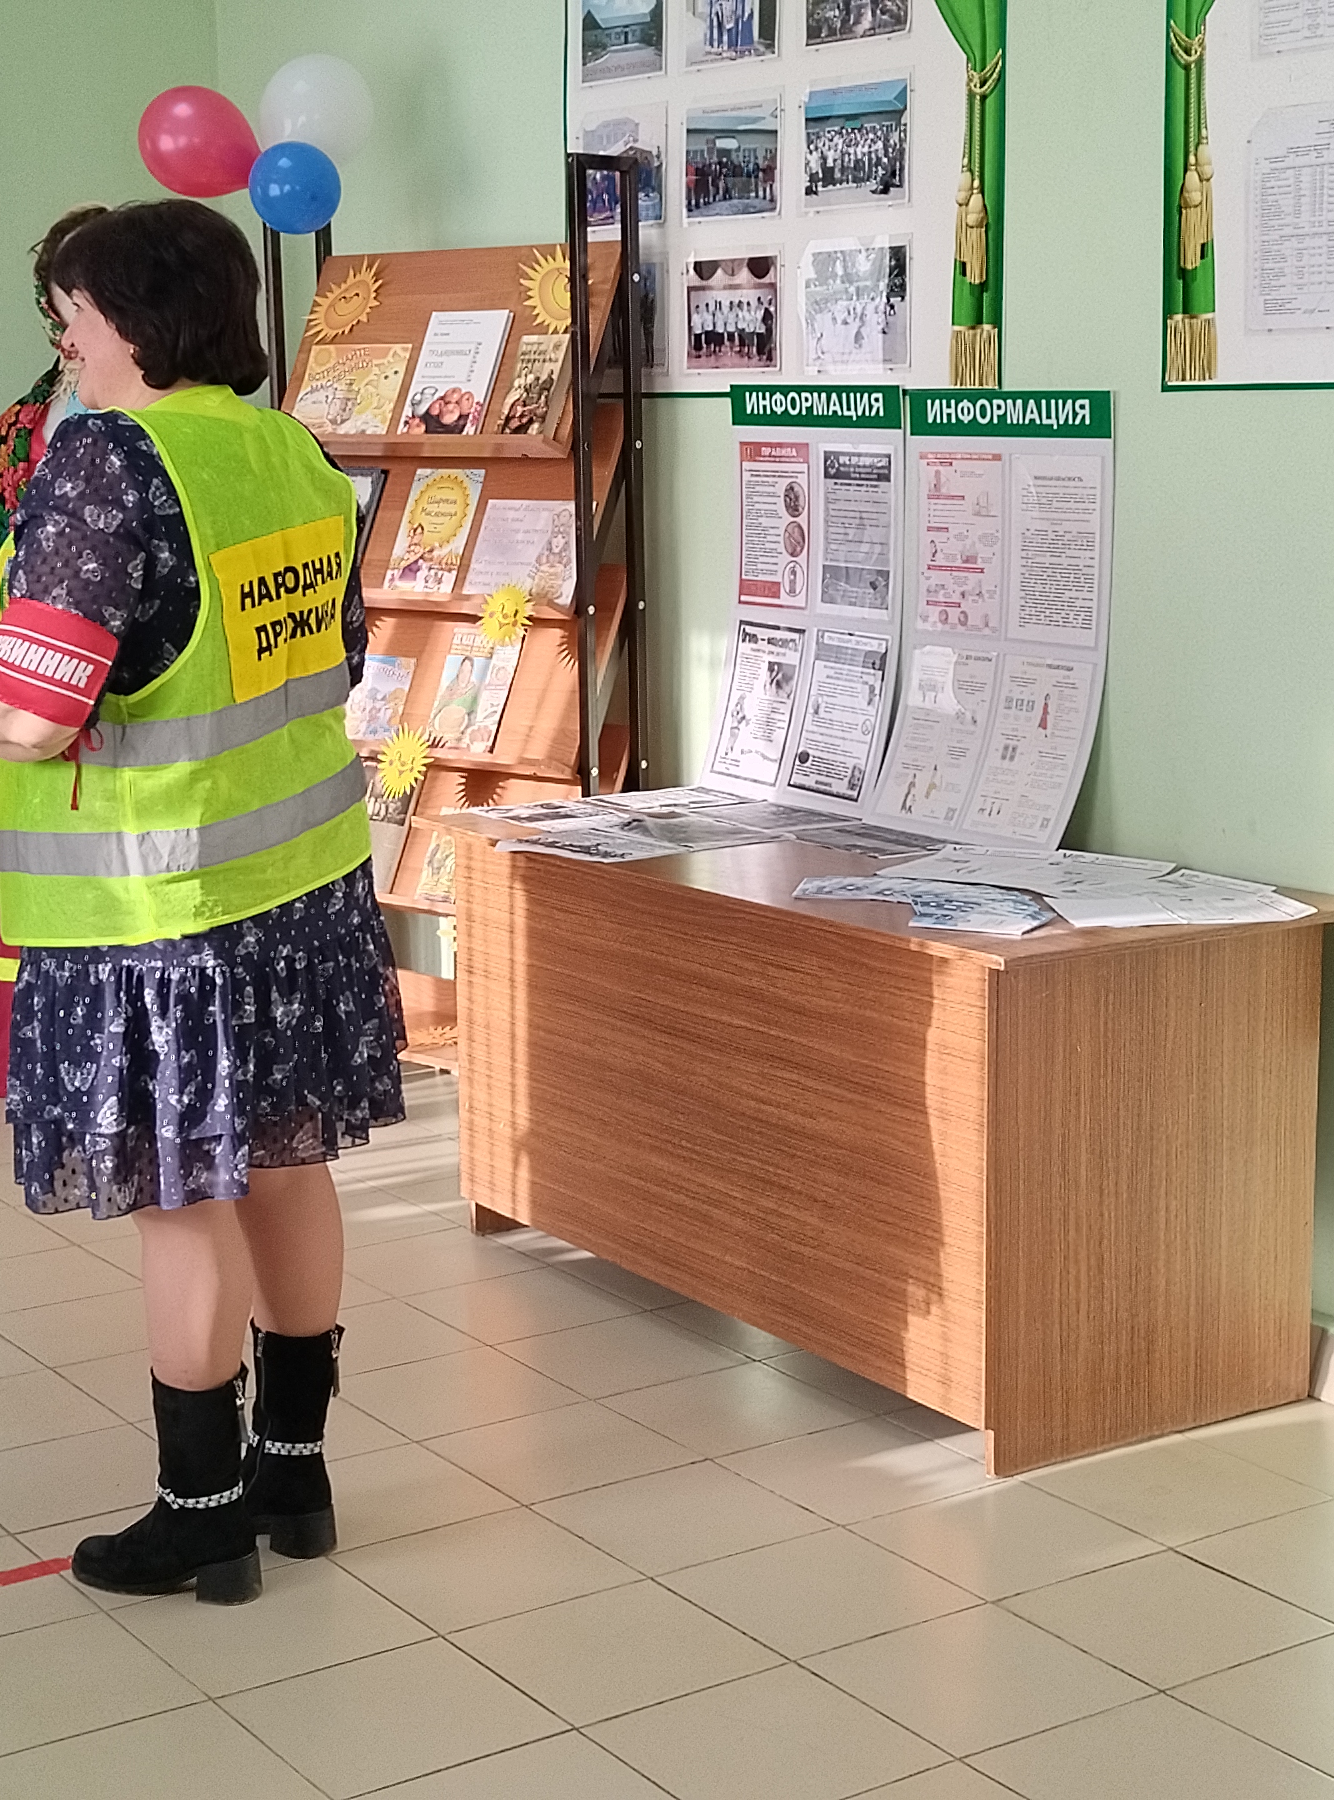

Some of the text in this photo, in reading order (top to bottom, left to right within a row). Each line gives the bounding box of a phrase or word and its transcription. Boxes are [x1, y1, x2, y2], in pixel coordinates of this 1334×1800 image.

[745, 391, 884, 421] ИНФОРМАЦИЯ
[926, 398, 1091, 430] ИНФОРМАЦИЯ
[240, 551, 342, 612] НАРОДНАЯ
